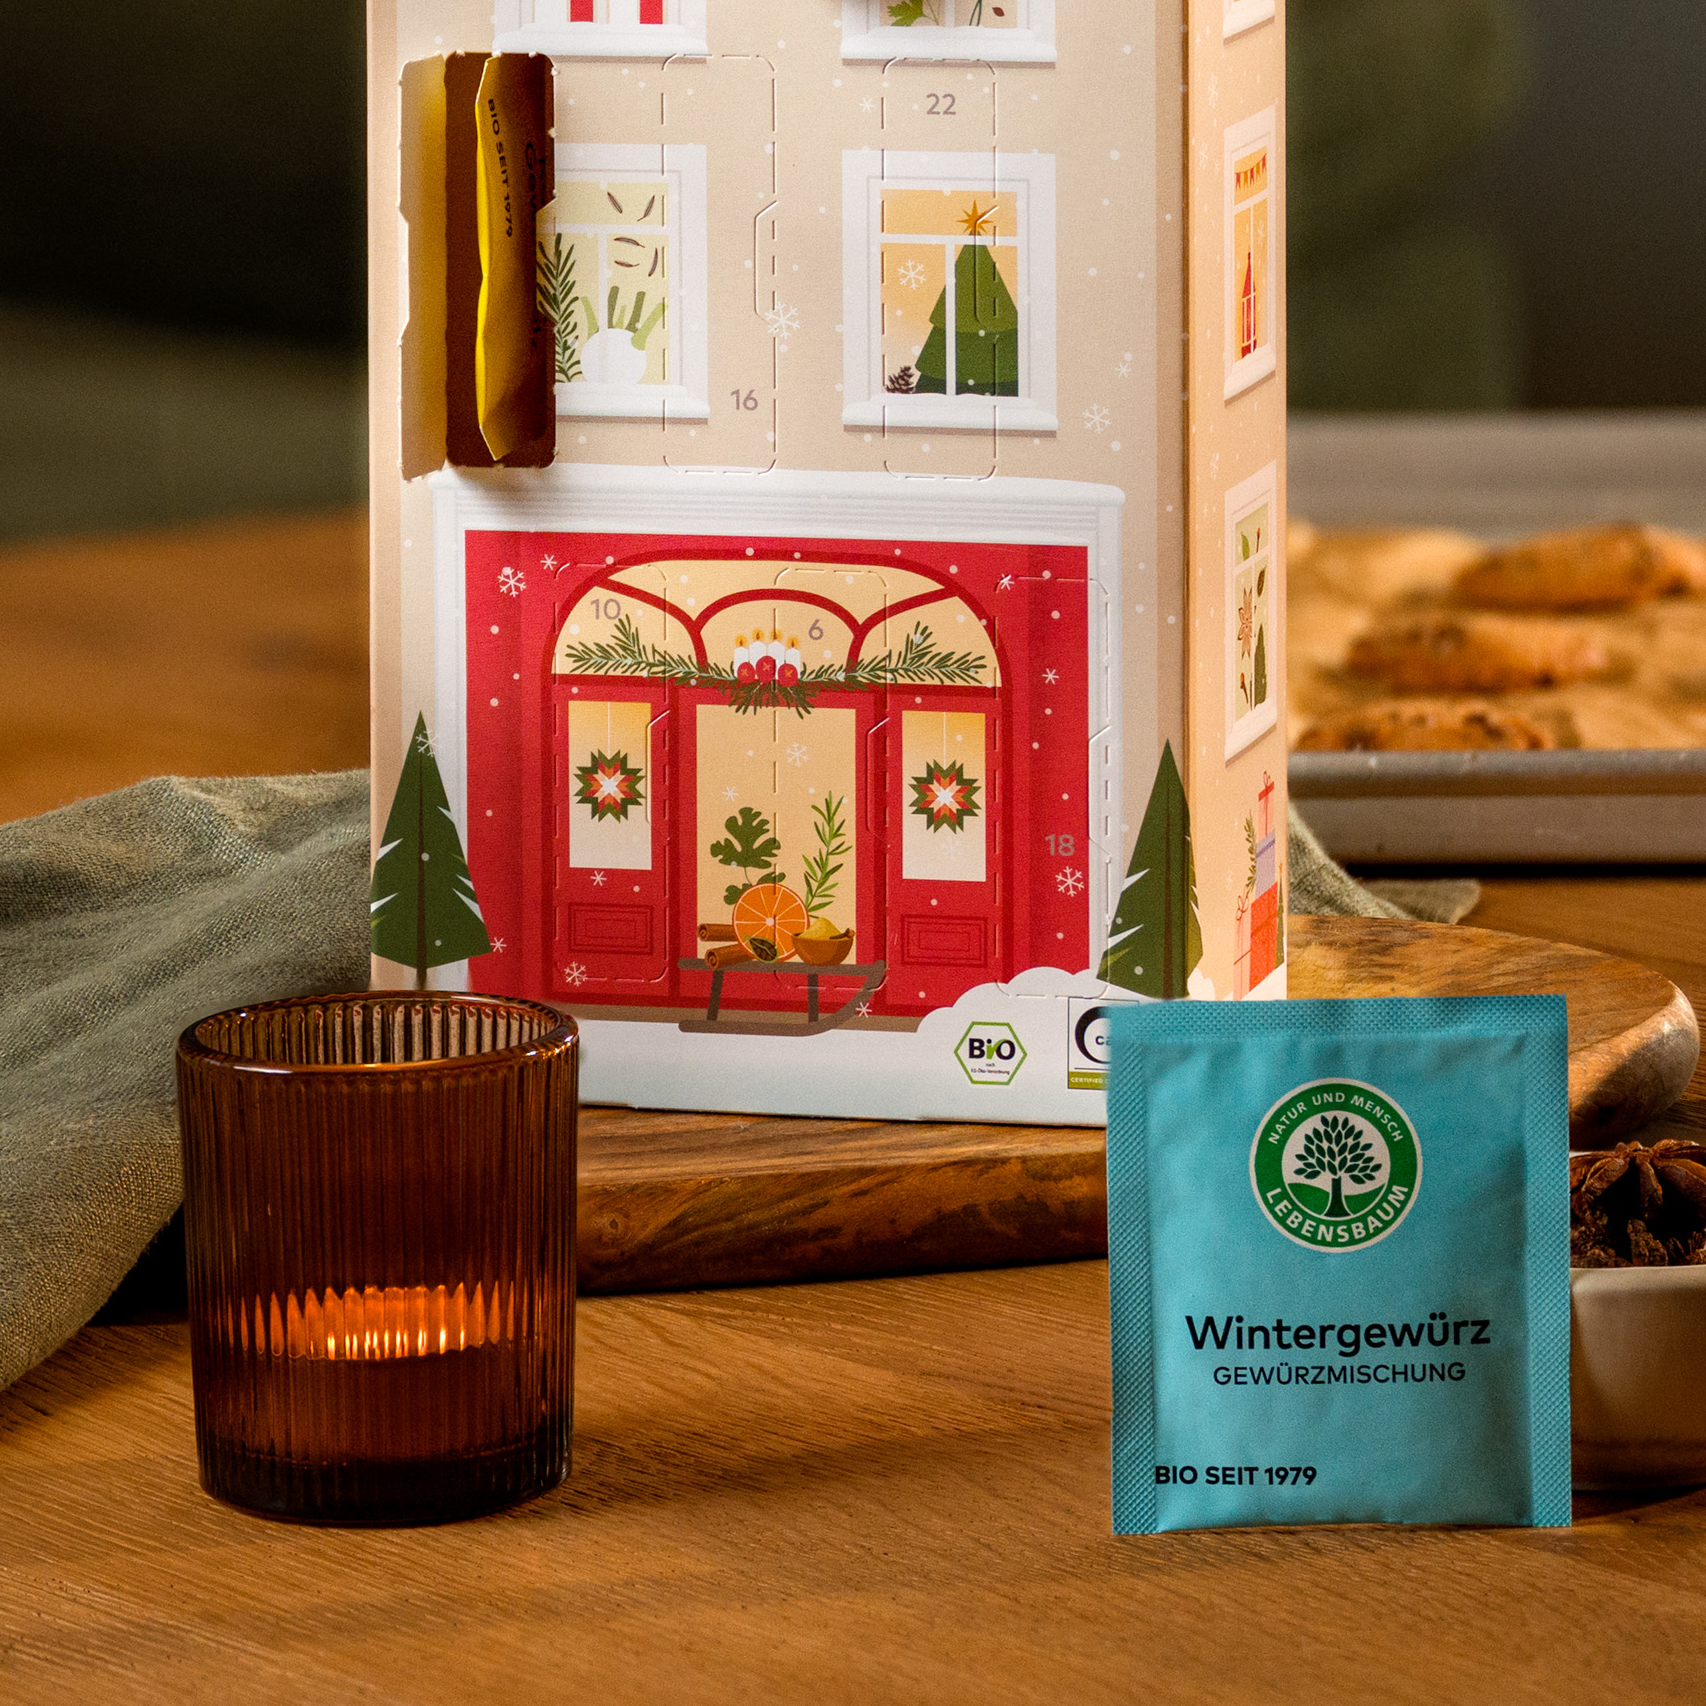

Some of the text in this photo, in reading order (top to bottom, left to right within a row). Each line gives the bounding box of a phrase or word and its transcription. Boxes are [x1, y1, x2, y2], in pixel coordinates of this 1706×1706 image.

[926, 93, 956, 115] 22
[488, 98, 513, 238] BIO SEIT 1979
[730, 389, 758, 411] 16
[589, 598, 621, 620] 10
[808, 618, 824, 641] 6
[1045, 834, 1075, 856] 18
[1268, 1092, 1404, 1144] NATUR UND MENSCH
[1266, 1184, 1409, 1243] LEBENSBAUM
[1185, 1311, 1492, 1357] Wintergewürz
[1212, 1360, 1466, 1386] GEWÜRZMISCHUNG
[1154, 1464, 1318, 1486] BIO SEIT 1979
